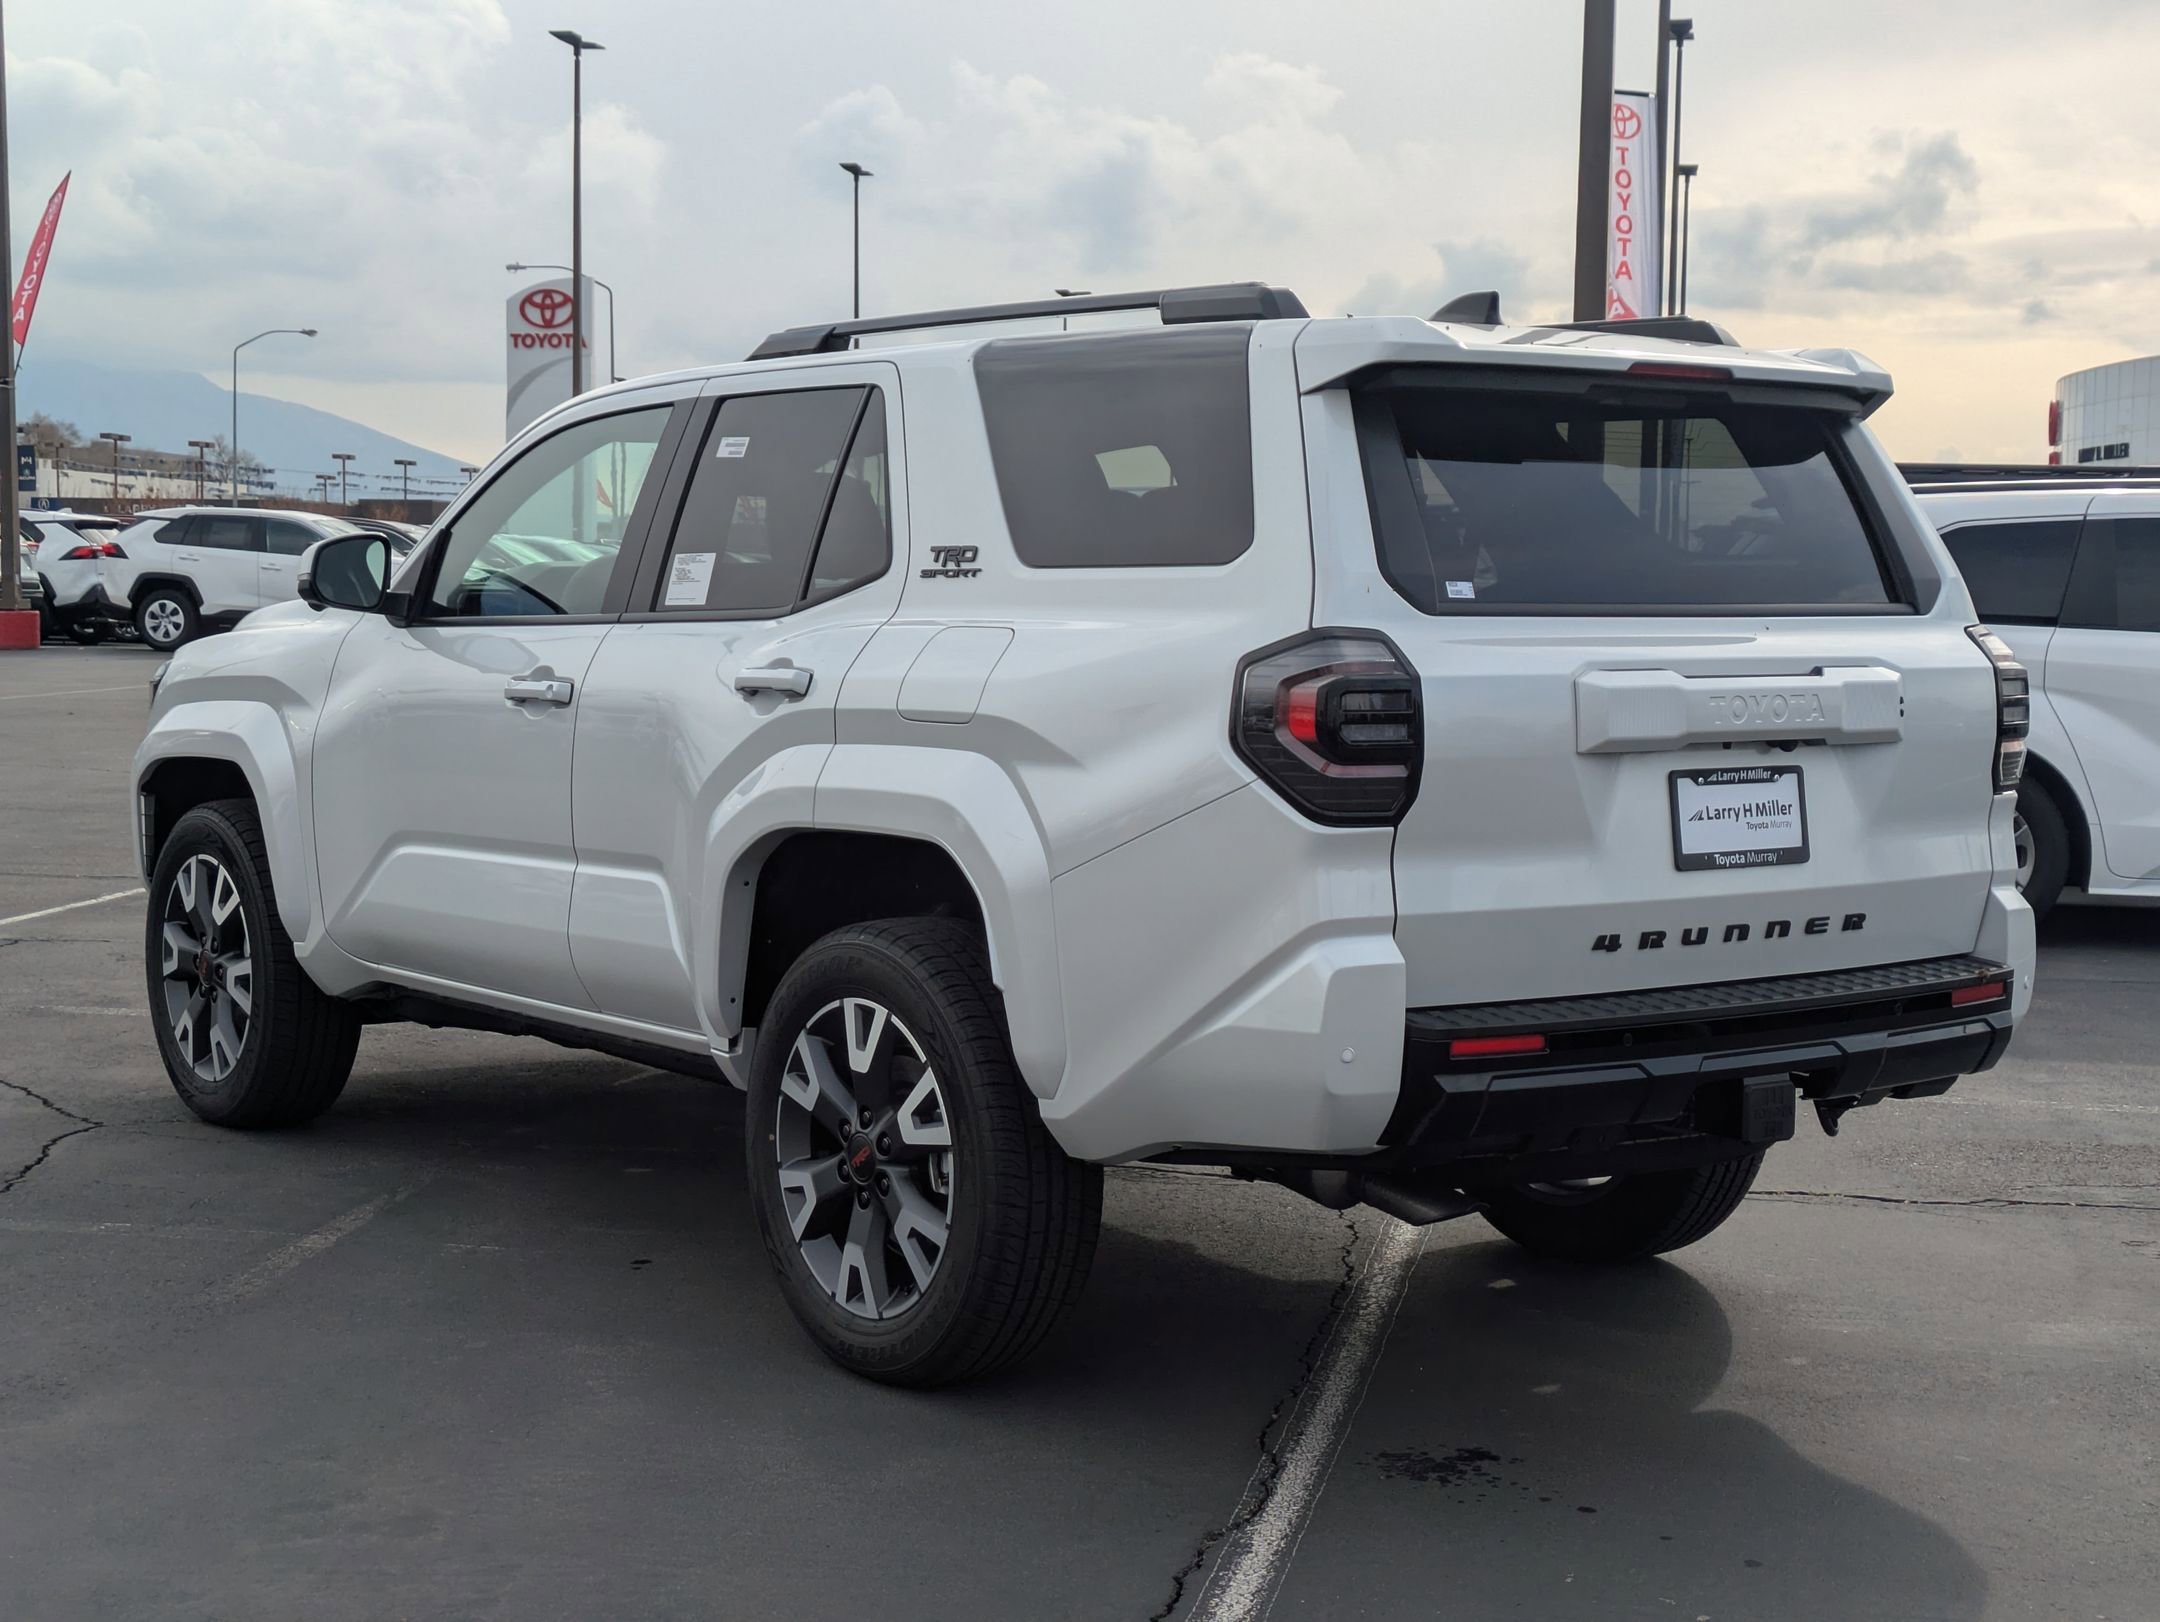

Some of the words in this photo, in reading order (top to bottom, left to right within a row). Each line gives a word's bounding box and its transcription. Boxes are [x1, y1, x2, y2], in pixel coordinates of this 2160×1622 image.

[1614, 146, 1633, 281] TOYOTA
[930, 545, 978, 568] TRD
[920, 568, 982, 578] SPORT
[1709, 693, 1825, 724] TOYOTA
[1718, 771, 1740, 782] Larry
[1740, 770, 1747, 780] H
[1747, 768, 1771, 779] Miller
[1706, 805, 1740, 822] Larry
[1743, 803, 1753, 818] H
[1756, 800, 1792, 817] Miller
[1746, 821, 1769, 831] Toyota
[1770, 820, 1792, 829] Murray
[1714, 853, 1745, 867] Toyota
[1747, 852, 1777, 864] Murray
[1591, 913, 1866, 952] 4RUNNER
